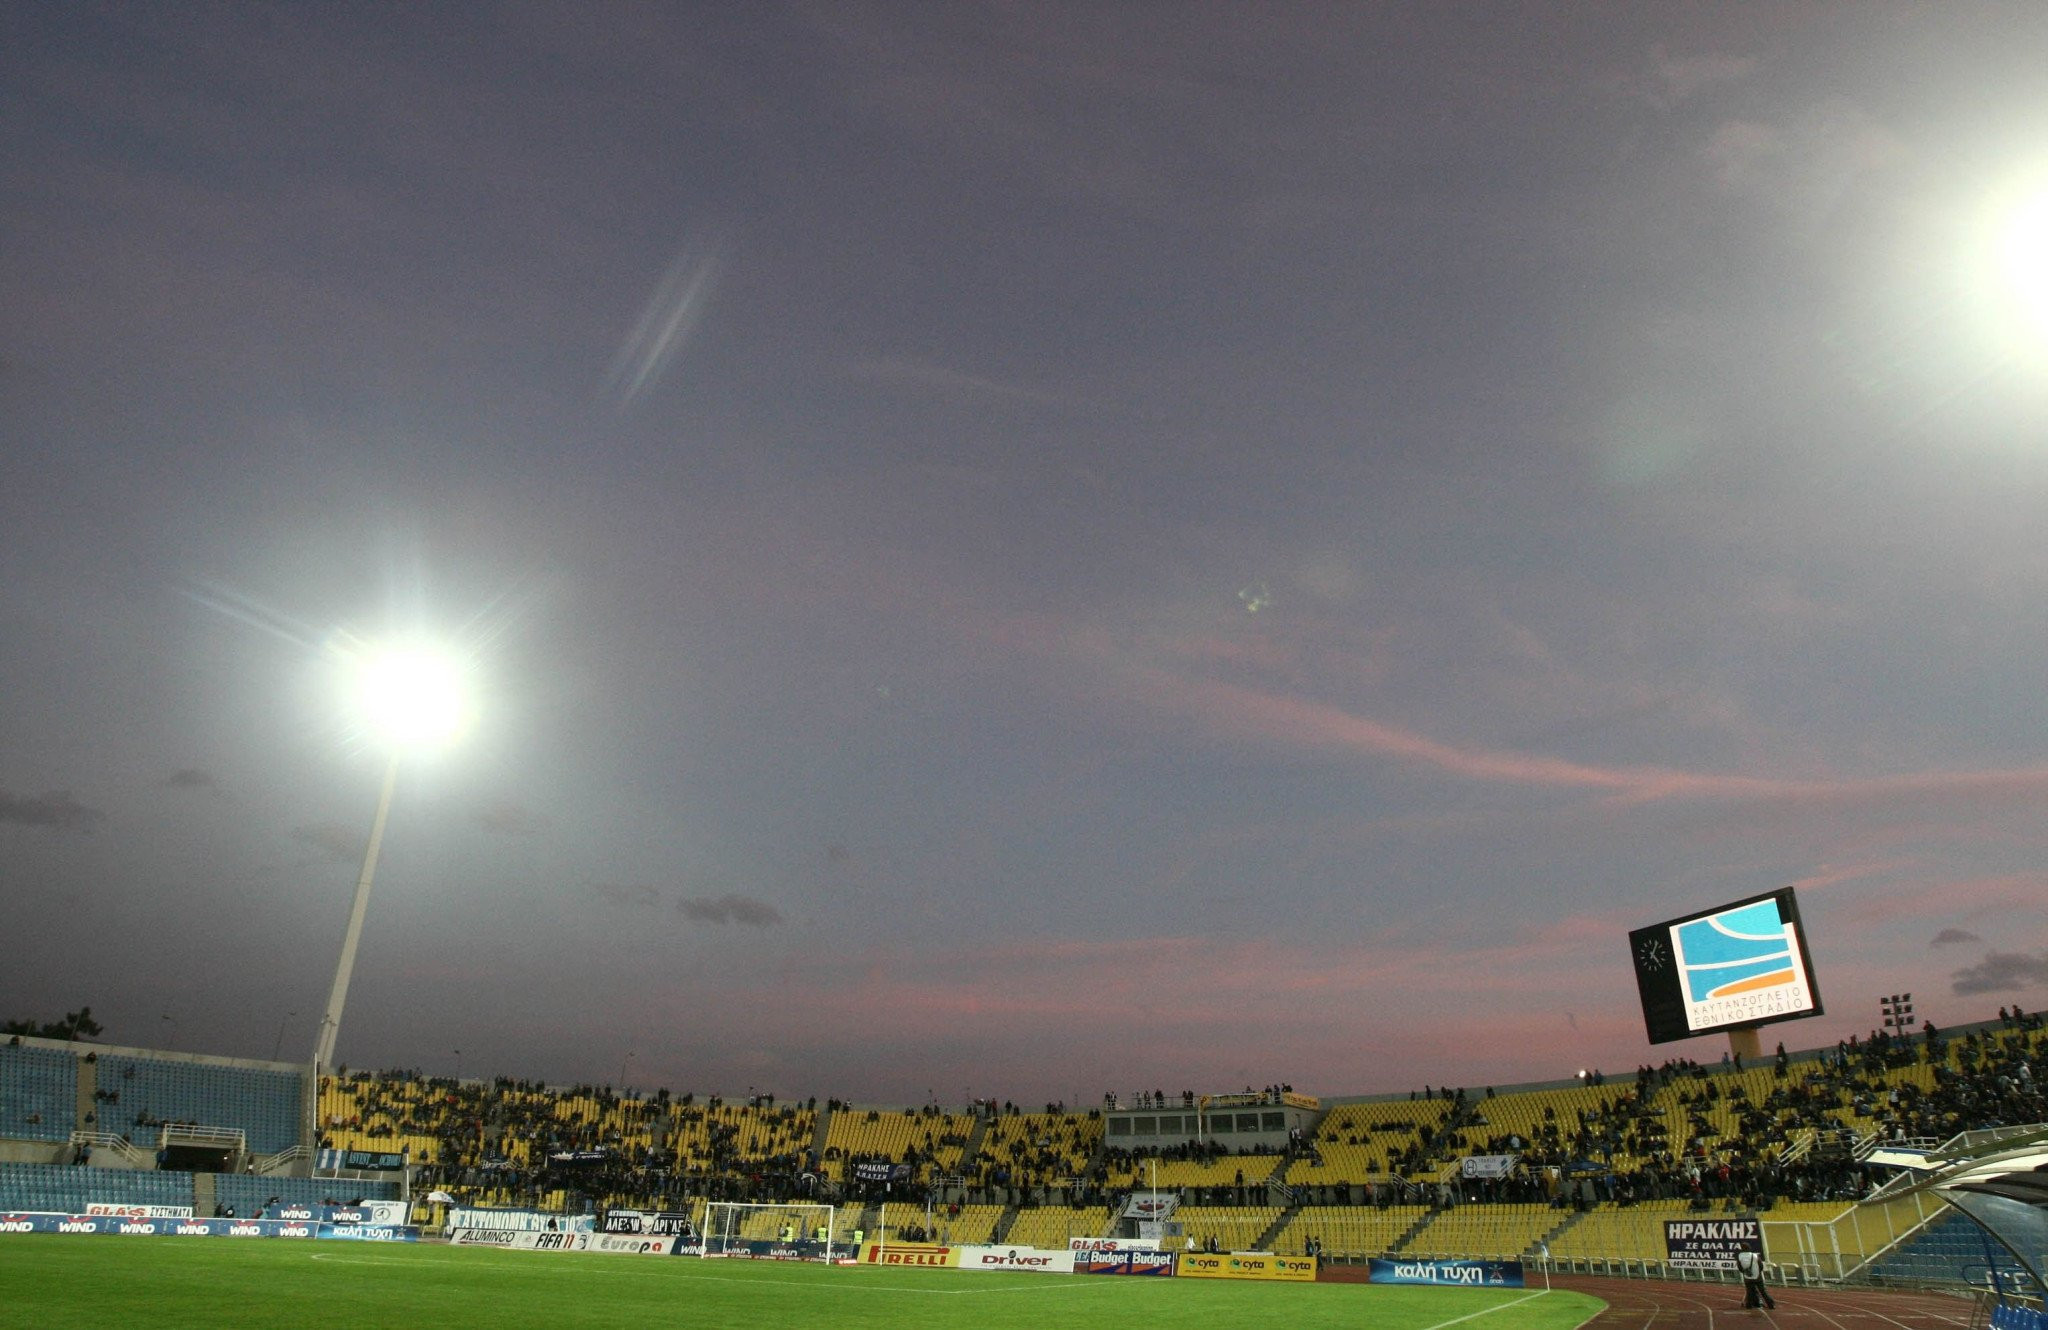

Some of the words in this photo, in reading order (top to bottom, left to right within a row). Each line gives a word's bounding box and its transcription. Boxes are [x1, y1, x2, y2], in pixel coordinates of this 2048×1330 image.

[1693, 986, 1800, 1016] ΚΑΥΤΑΝΖΟΓΛΕΙΟ
[1695, 1009, 1744, 1027] ΕΘΝΙΚΟ
[1749, 998, 1803, 1017] ΣΤΑΔΙΟ
[280, 1209, 312, 1219] WIND
[332, 1212, 362, 1221] WIND
[59, 1222, 97, 1233] WIND
[120, 1223, 155, 1234] WIND
[177, 1225, 209, 1235] WIND
[229, 1225, 261, 1235] WIND
[279, 1227, 309, 1237] WIND
[1668, 1221, 1758, 1239] ΗΡΑΚΛΗΣ
[460, 1230, 515, 1243] ALUMINCO
[535, 1233, 564, 1249] FIFA
[563, 1234, 575, 1249] 11
[1685, 1242, 1698, 1250] ΣΕ
[1702, 1242, 1723, 1250] ΟΛΑ
[1728, 1242, 1742, 1250] ΤΑ
[868, 1246, 950, 1265] PIRELLI
[982, 1250, 1052, 1265] Driver
[1090, 1251, 1129, 1266] Budget
[1132, 1252, 1171, 1267] Budget
[1671, 1251, 1711, 1259] ΠΕΤΑΛΑ
[1715, 1251, 1735, 1259] ΤΗΣ
[1198, 1259, 1219, 1270] cyta
[1243, 1260, 1264, 1271] cyta
[1288, 1261, 1311, 1272] cyta
[1673, 1260, 1717, 1268] ΗΡΑΚΛΗΣ
[1394, 1262, 1437, 1282] καλή
[1441, 1262, 1483, 1284] τύχη
